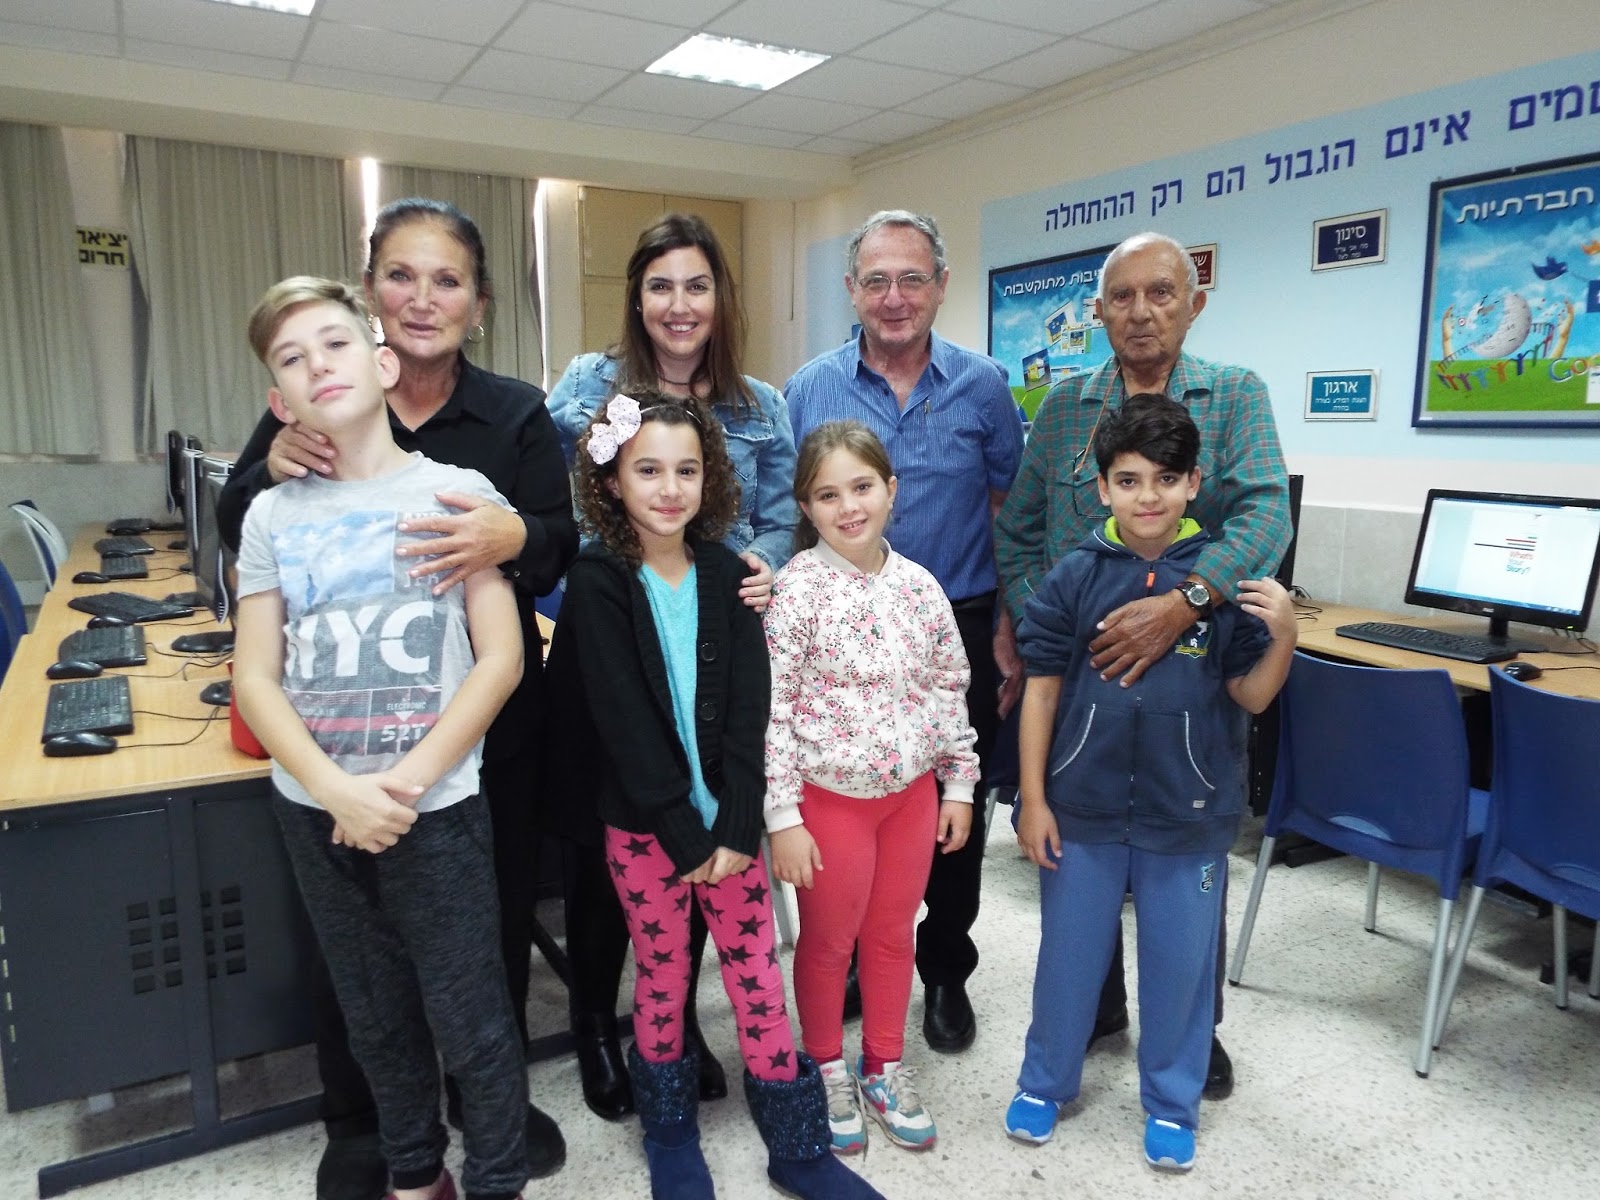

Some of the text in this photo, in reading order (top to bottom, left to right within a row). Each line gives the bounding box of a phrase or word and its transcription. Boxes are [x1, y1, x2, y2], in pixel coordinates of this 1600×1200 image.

[1385, 110, 1471, 159] אינם
[1265, 138, 1356, 185] הגבול
[1151, 179, 1183, 217] רק
[1206, 165, 1245, 198] הם
[1045, 190, 1135, 232] ההתחלה
[1456, 186, 1594, 224] חברתיות
[1335, 225, 1367, 245] סינון
[1003, 275, 1066, 297] מתוקשבות
[1323, 381, 1359, 397] ארגון
[386, 701, 427, 711] ELECTRONIC
